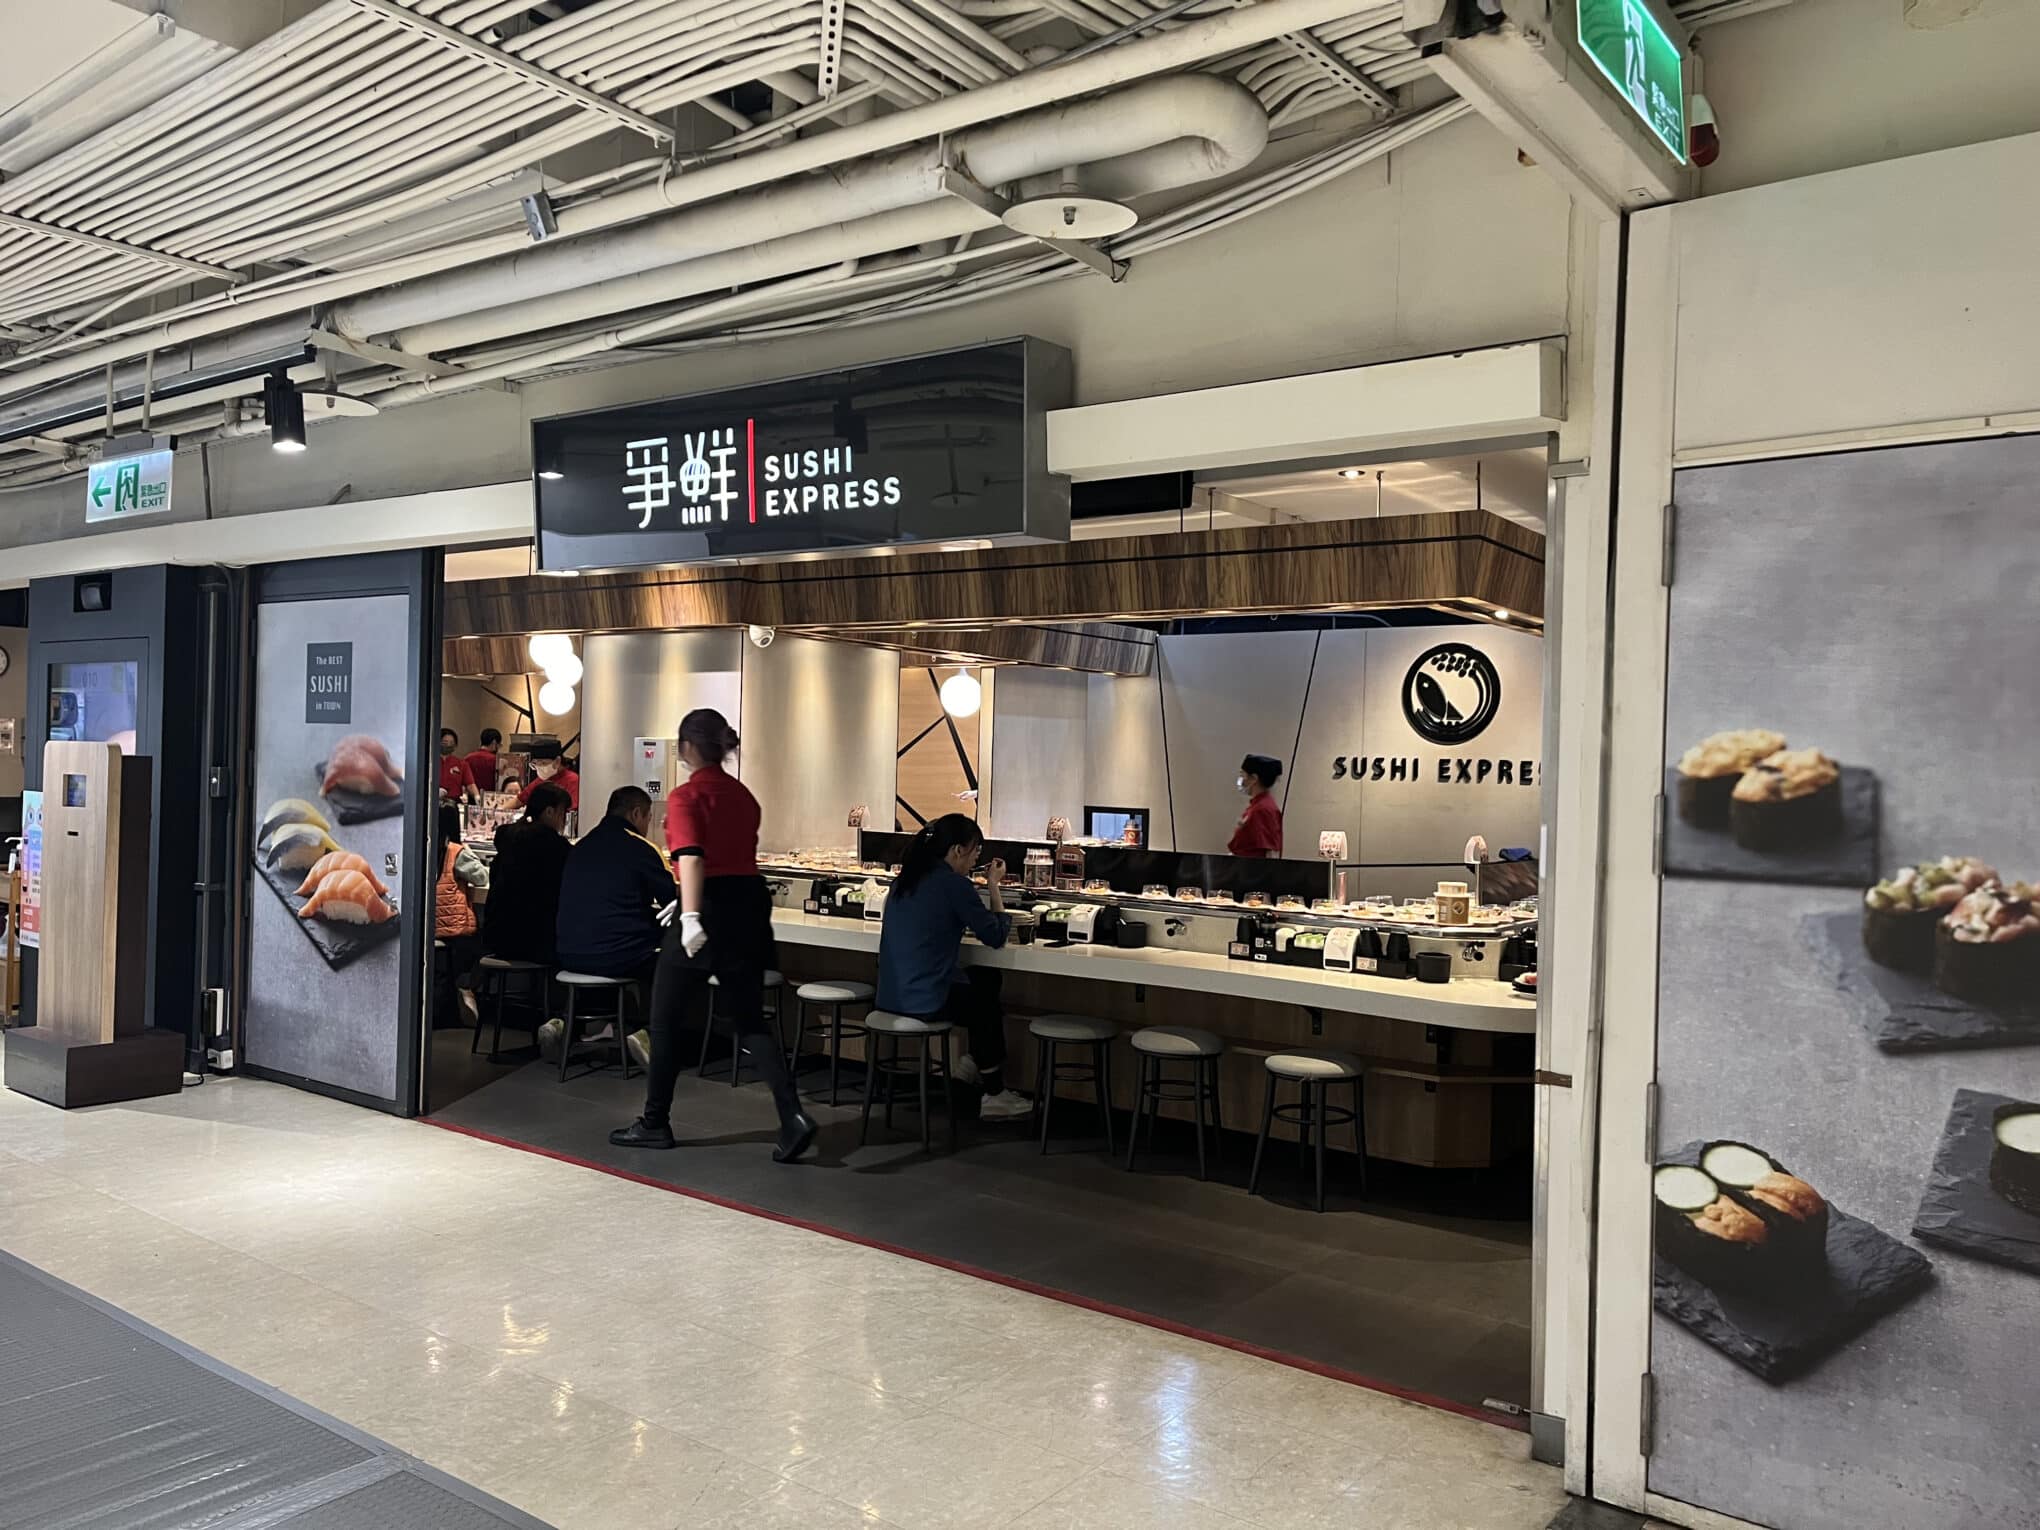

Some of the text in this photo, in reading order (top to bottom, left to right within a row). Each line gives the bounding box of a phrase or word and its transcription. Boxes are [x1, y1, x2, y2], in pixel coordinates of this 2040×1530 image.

[1654, 111, 1680, 150] EXIT
[622, 427, 739, 528] 爭鮮
[764, 445, 852, 482] SUSHI
[141, 497, 165, 508] EXIT
[765, 476, 901, 517] EXPRESS
[328, 655, 343, 665] BEST
[310, 675, 348, 693] SUSHI
[1332, 756, 1542, 786] SUSHI EXPRE
